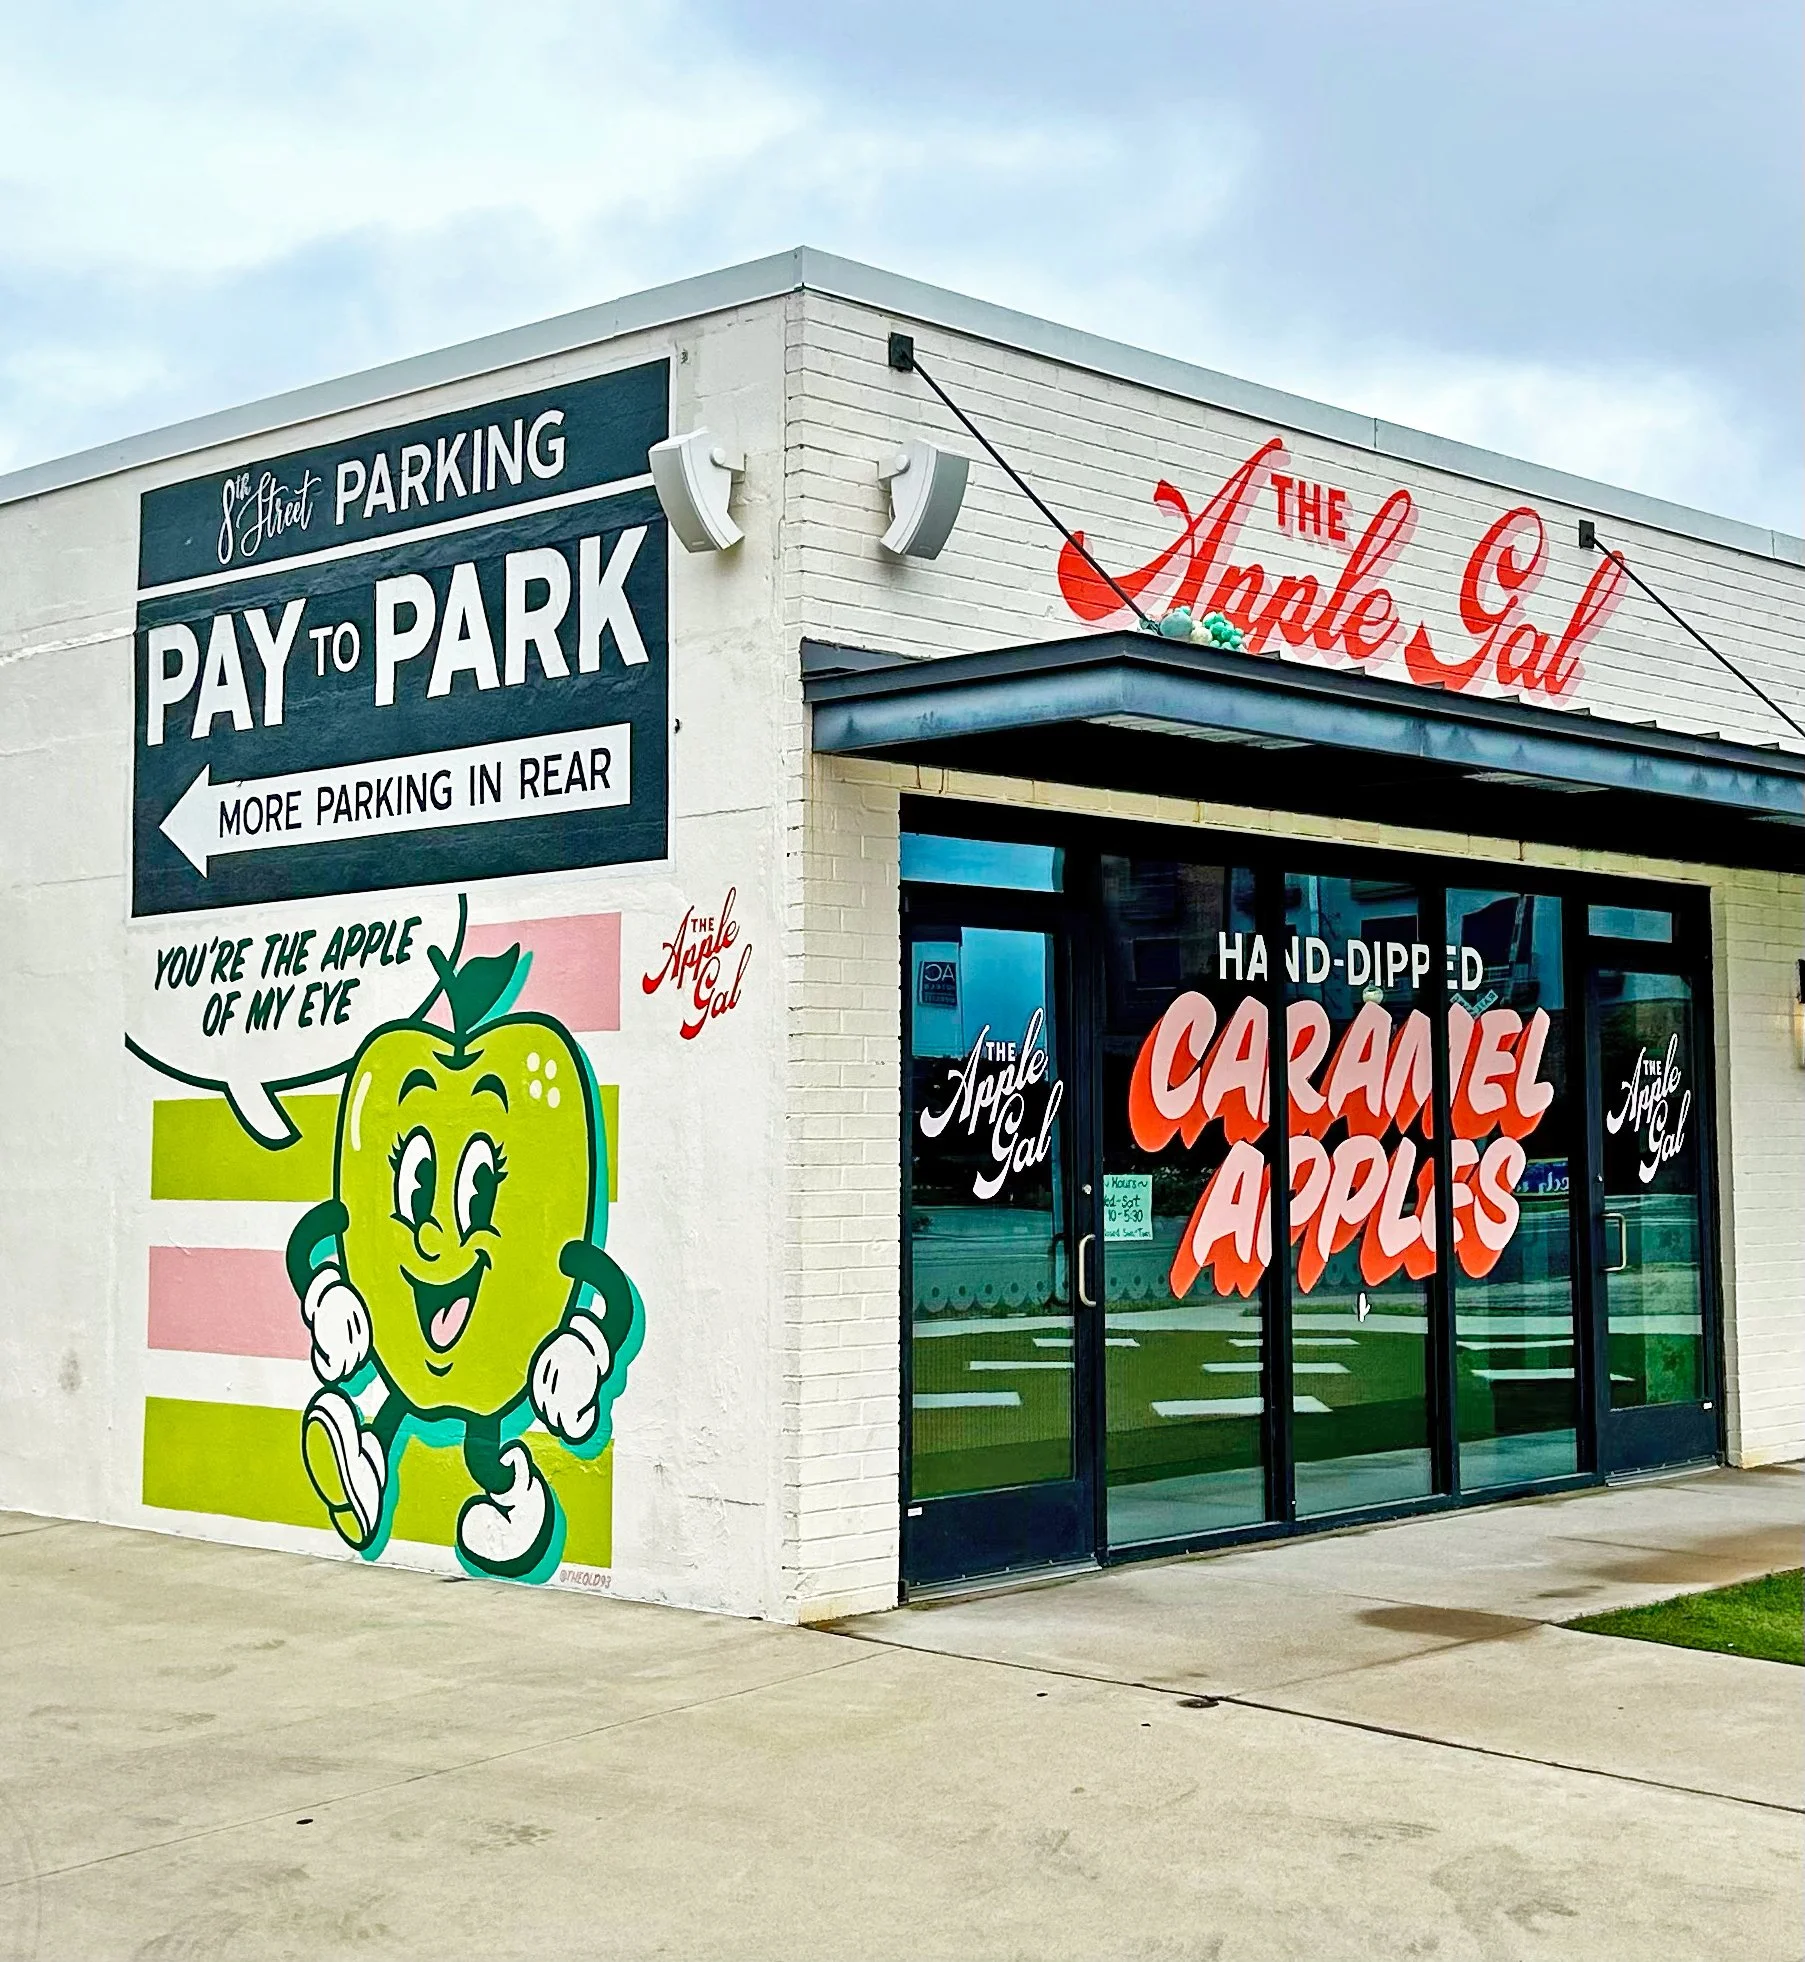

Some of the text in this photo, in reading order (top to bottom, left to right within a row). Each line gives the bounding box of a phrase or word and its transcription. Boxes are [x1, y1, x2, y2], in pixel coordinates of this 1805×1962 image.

[217, 409, 566, 565] 8th Street PARKING
[1270, 472, 1351, 550] THE
[1058, 437, 1627, 702] Apple Gal
[146, 524, 650, 747] PAY TO PARK
[218, 747, 612, 838] MORE PARKING IN REAR
[154, 916, 422, 991] YOU'RE THE APPLE
[642, 887, 741, 995] Apple
[691, 917, 715, 933] THE
[202, 978, 361, 1037] OF MY EYE
[679, 943, 753, 1041] Gal
[920, 1007, 1049, 1138] Apple
[985, 1041, 1016, 1062] THE
[1129, 991, 1554, 1152] CARAMEL
[1606, 1033, 1682, 1134] Apple
[1643, 1060, 1662, 1076] THE
[972, 1080, 1064, 1200] Gal
[1638, 1089, 1692, 1184] Gal
